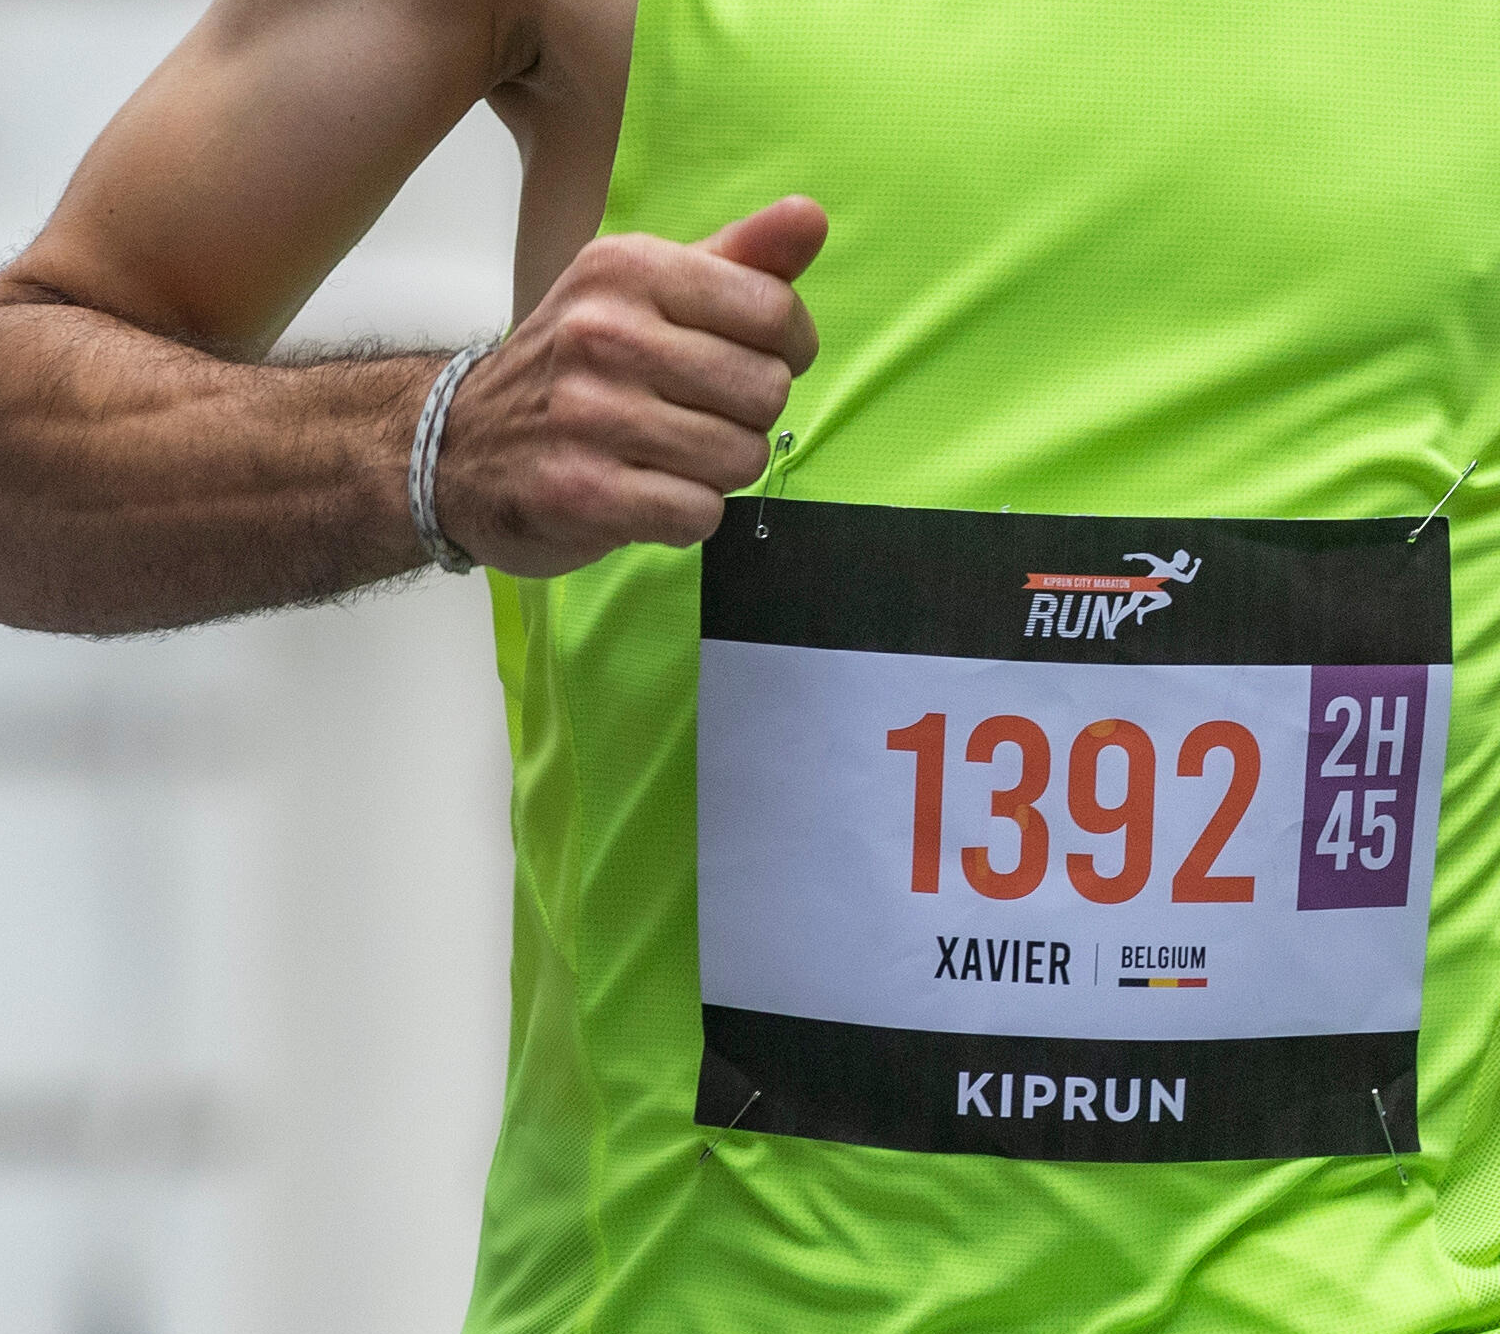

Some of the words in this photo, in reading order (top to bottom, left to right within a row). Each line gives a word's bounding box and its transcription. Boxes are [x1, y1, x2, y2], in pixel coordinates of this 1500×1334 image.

[1074, 577, 1092, 588] CITY
[1093, 578, 1131, 589] MARATON
[1023, 593, 1125, 640] RUN
[1319, 695, 1409, 780] 2H
[885, 711, 1262, 905] 1392
[1315, 790, 1397, 873] 45
[933, 936, 1072, 987] XAVIER
[1120, 945, 1207, 970] BELGIUM
[956, 1071, 1187, 1124] KIPRUN
